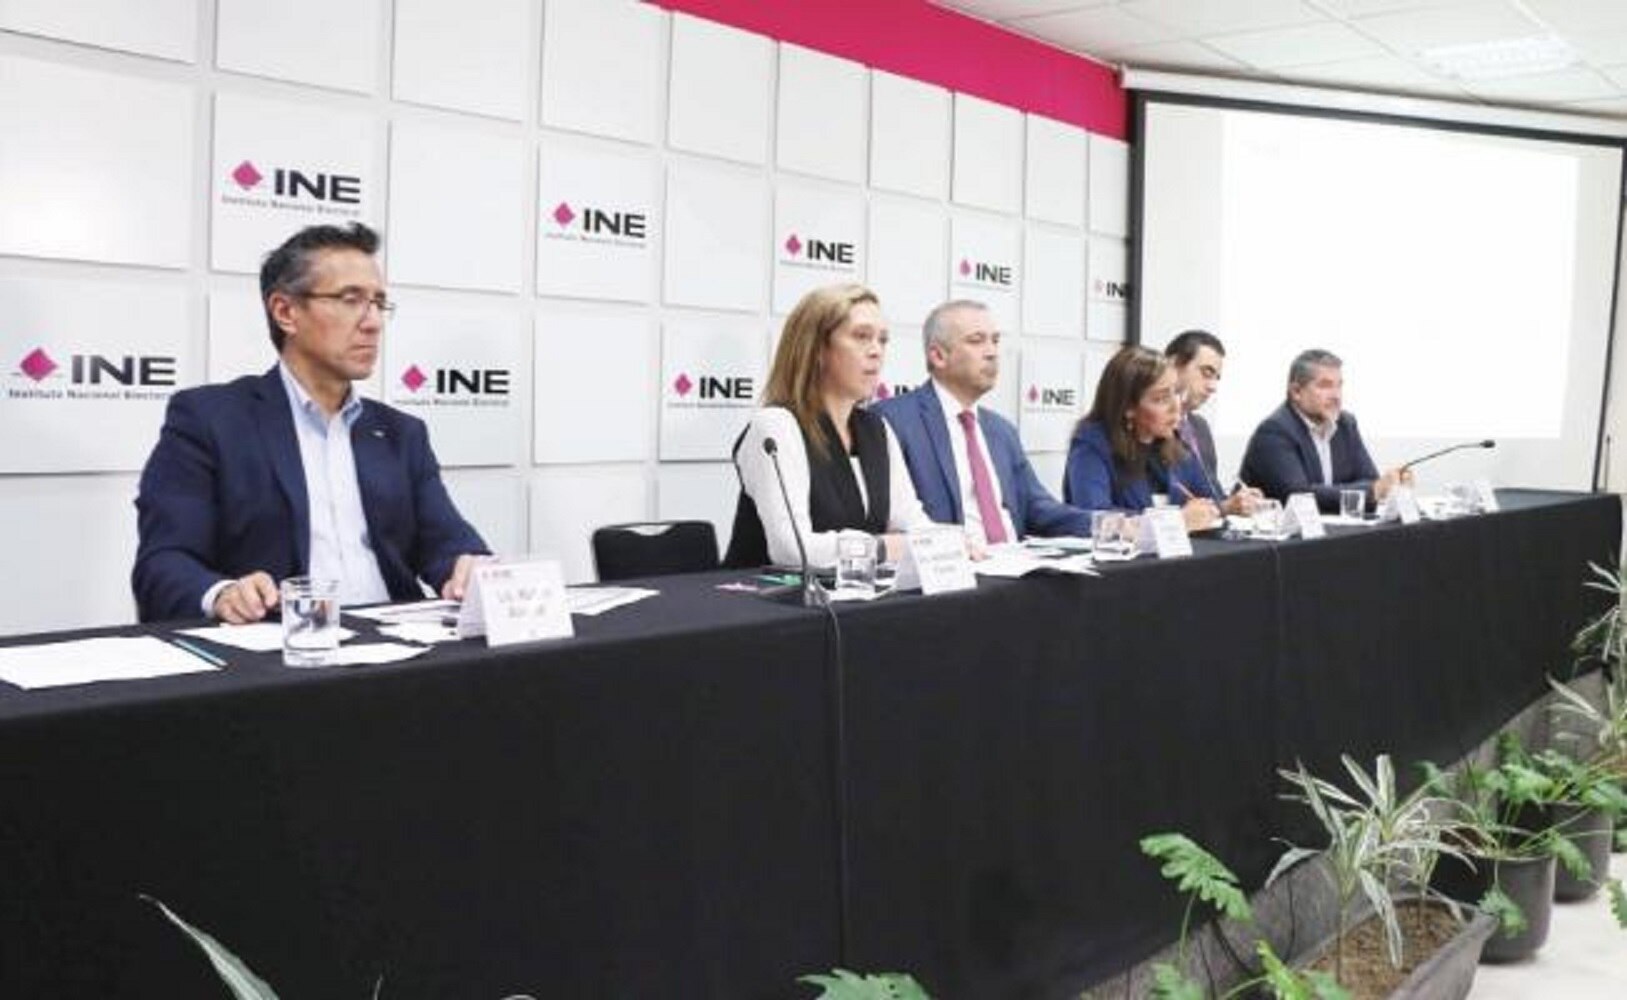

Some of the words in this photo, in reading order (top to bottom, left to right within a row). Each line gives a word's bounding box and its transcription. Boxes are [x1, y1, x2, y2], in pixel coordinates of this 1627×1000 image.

[274, 168, 361, 204] INE
[583, 208, 646, 239] INE
[807, 239, 854, 263] INE
[976, 262, 1012, 286] INE
[1106, 281, 1128, 299] IN
[72, 355, 176, 386] INE
[437, 369, 510, 395] INE
[699, 376, 753, 399] INE
[1042, 388, 1076, 406] INE
